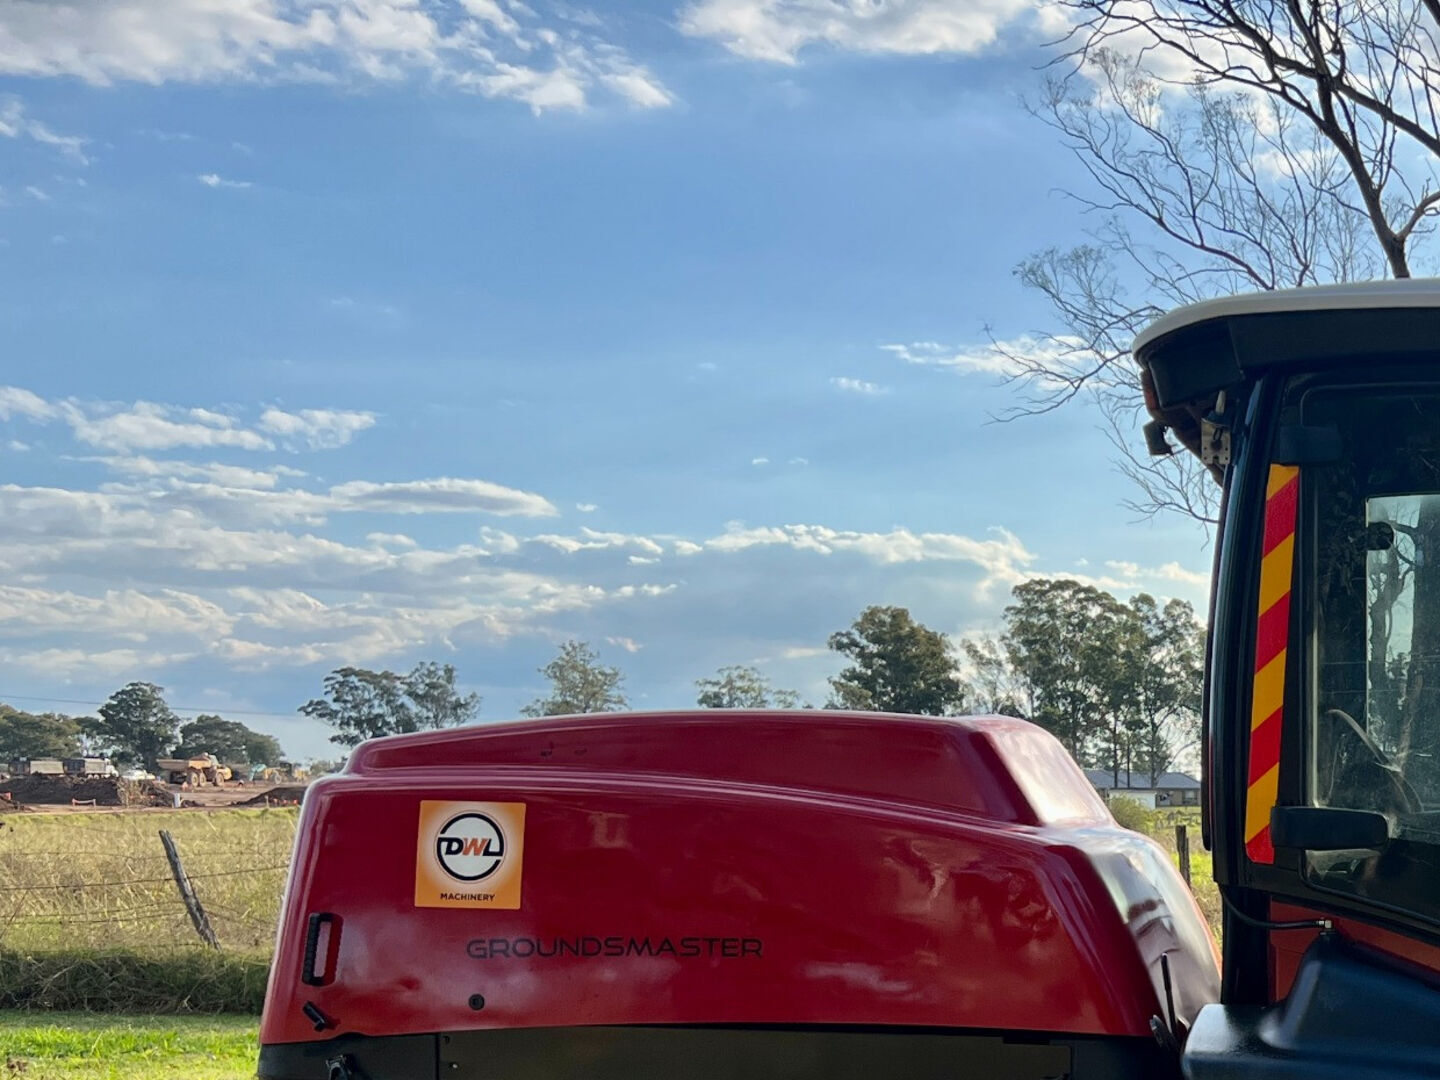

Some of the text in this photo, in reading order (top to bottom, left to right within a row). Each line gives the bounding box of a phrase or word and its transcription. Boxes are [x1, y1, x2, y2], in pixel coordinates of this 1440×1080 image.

[437, 837, 504, 857] DWL
[440, 892, 496, 902] MACHINERY
[466, 936, 763, 960] GROUNDSMASTER
